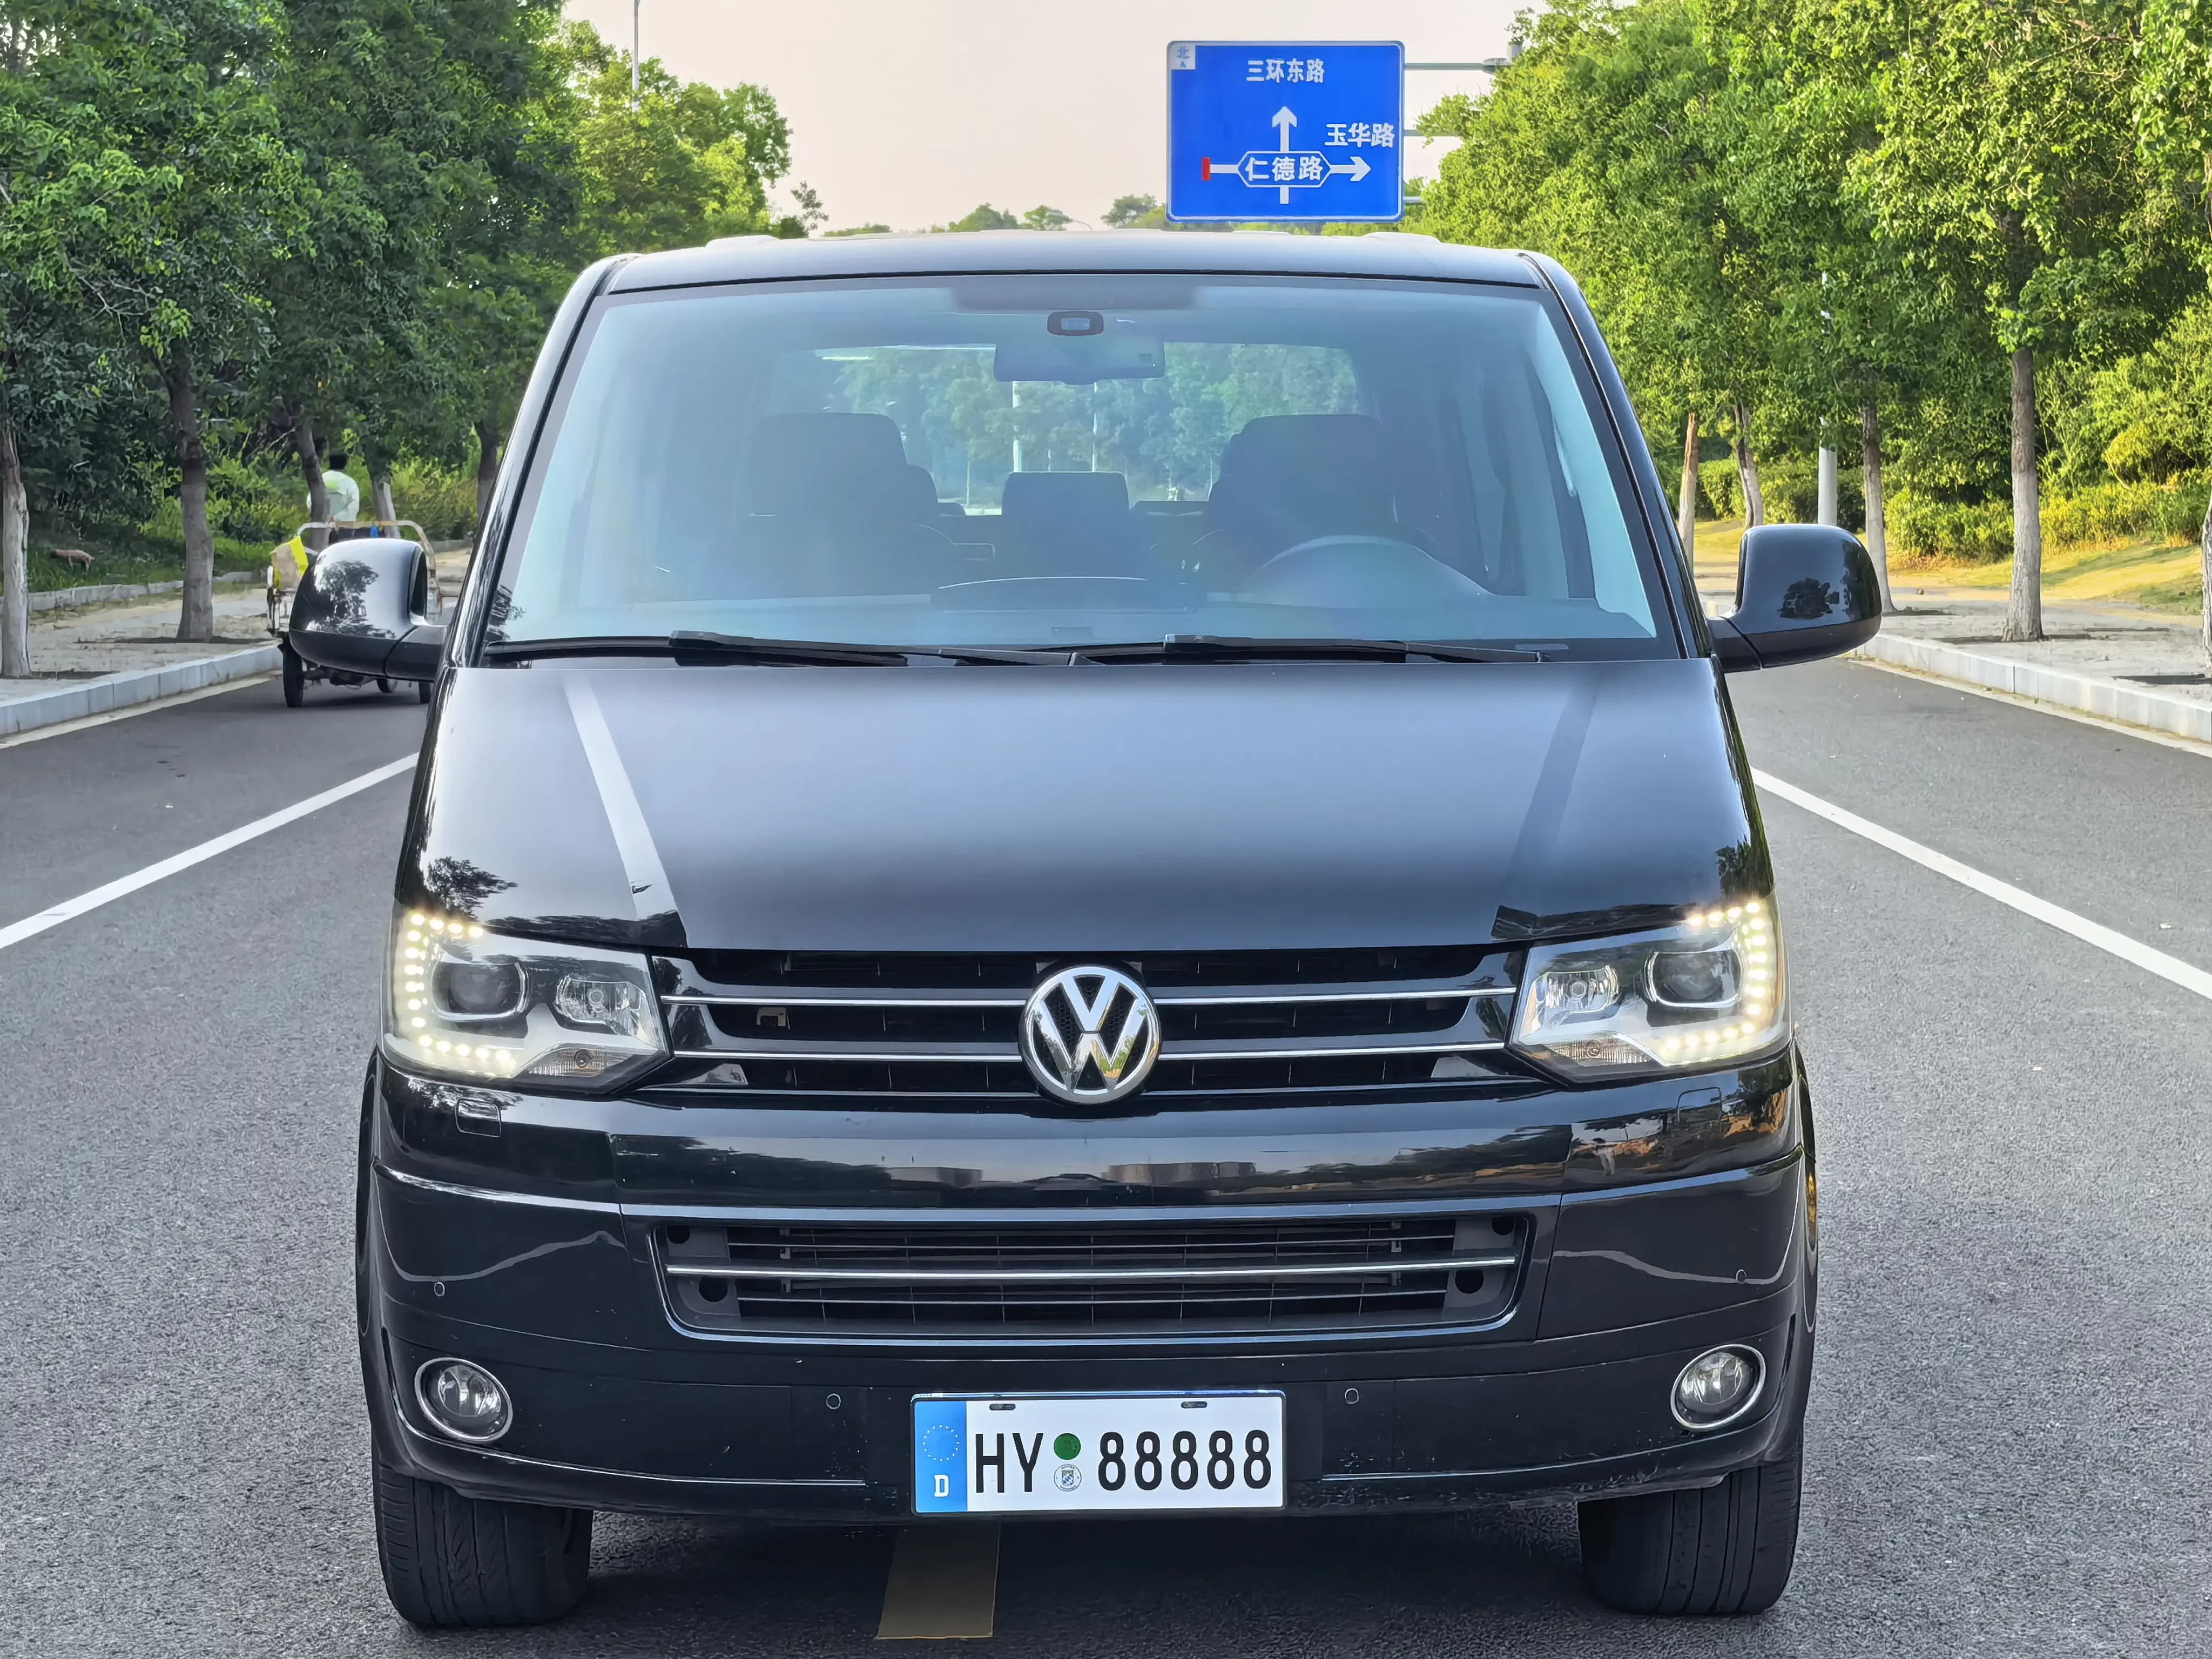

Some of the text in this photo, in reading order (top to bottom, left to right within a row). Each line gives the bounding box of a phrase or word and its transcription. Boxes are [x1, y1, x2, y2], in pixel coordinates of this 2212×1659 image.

[1246, 58, 1325, 83] 三环东路
[1324, 122, 1395, 148] 玉华路
[1245, 156, 1324, 181] 仁德路
[975, 1433, 1044, 1493] HY
[1098, 1429, 1271, 1491] 88888
[934, 1474, 949, 1498] D
